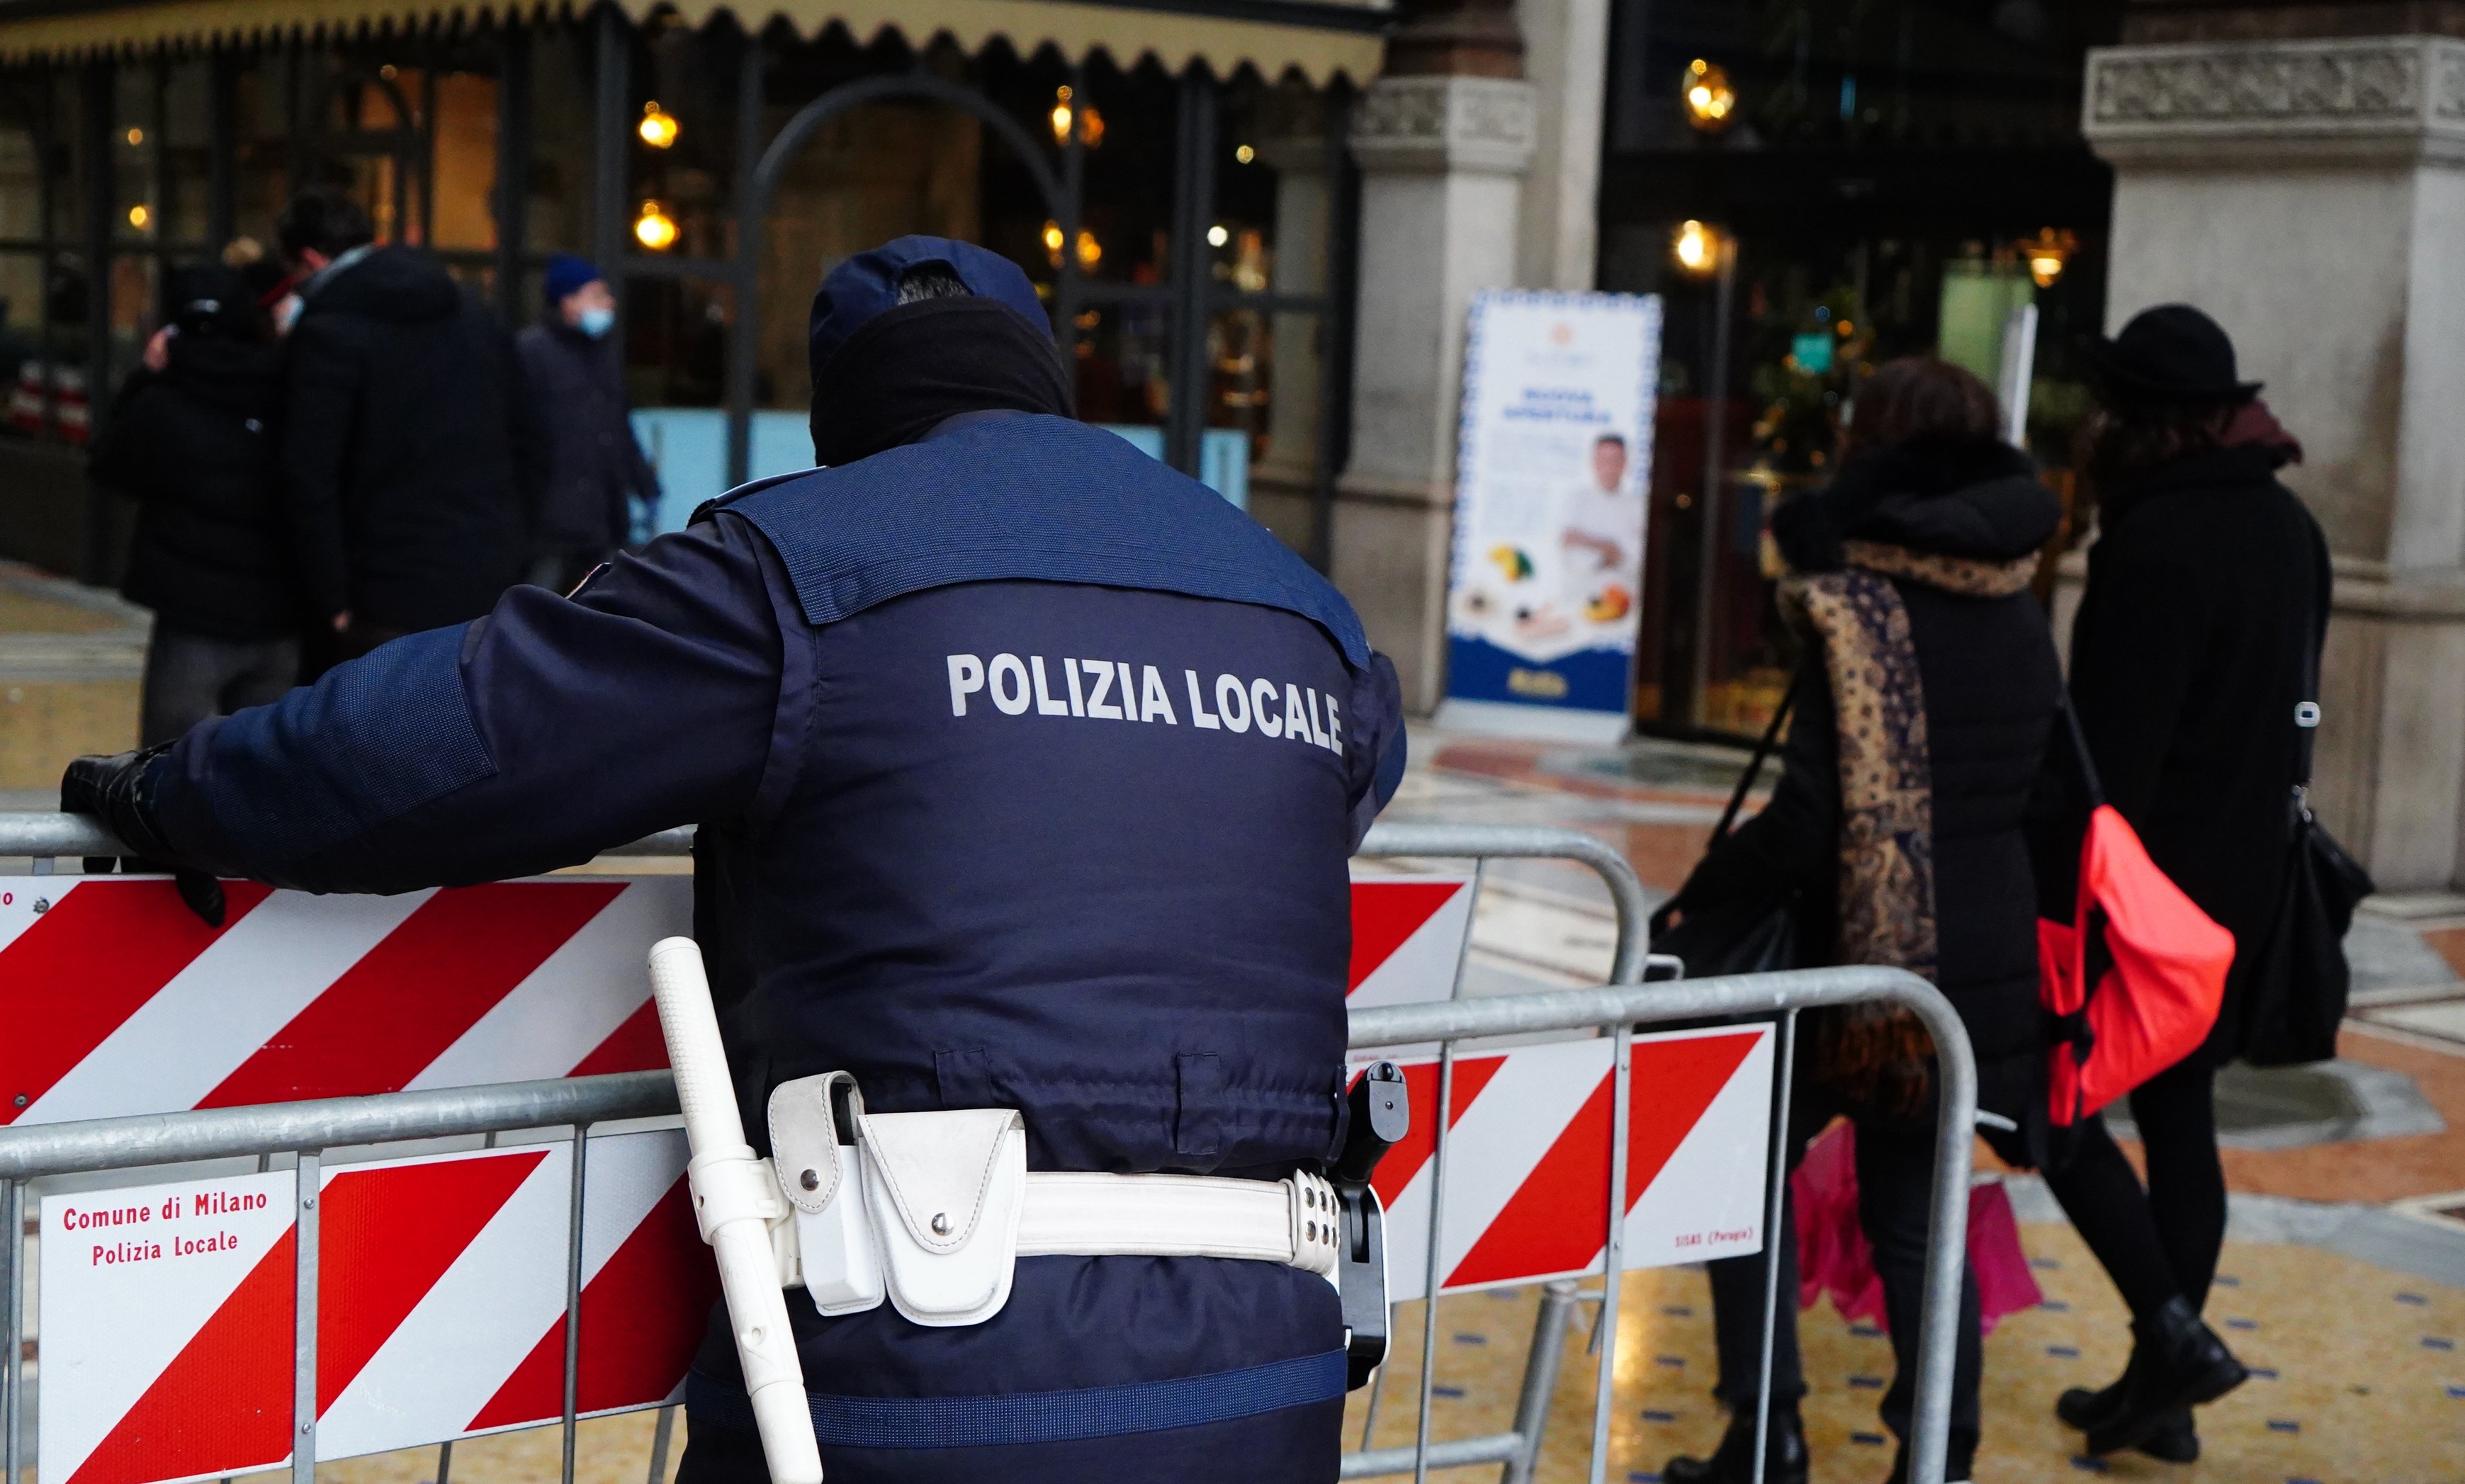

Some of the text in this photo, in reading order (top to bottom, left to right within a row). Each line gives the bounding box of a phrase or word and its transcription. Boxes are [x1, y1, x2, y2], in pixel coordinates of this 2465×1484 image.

[947, 652, 1343, 757] POLIZIA LOCALE
[63, 1192, 267, 1231] Comune di Milano
[92, 1231, 238, 1267] Polizia Locale
